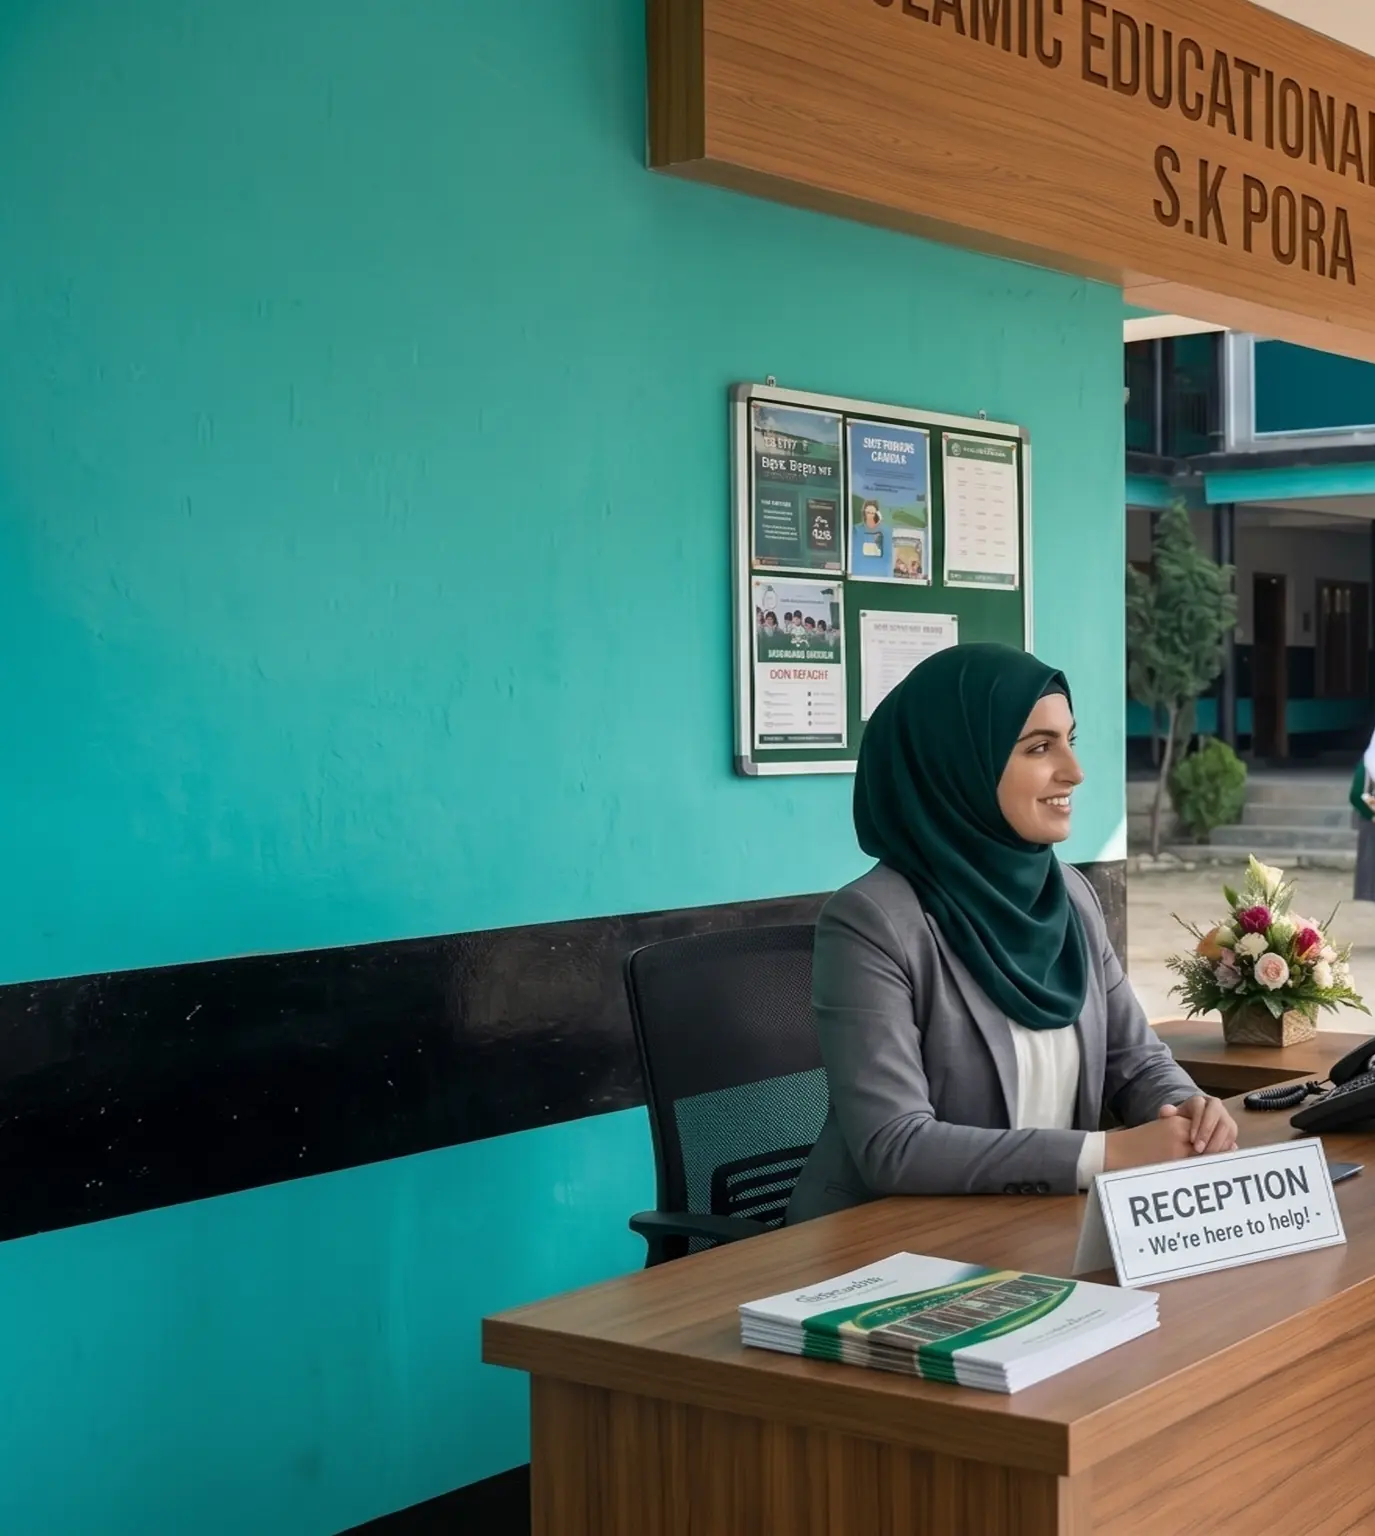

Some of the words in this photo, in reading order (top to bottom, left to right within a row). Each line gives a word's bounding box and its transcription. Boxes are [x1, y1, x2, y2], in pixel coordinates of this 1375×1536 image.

[873, 0, 1063, 69] MIC
[1152, 144, 1228, 246] S.K
[1242, 173, 1356, 286] PORA
[1128, 1165, 1311, 1227] RECEPTION
[1148, 1231, 1200, 1255] We're
[1203, 1224, 1244, 1244] here
[1247, 1218, 1265, 1235] to
